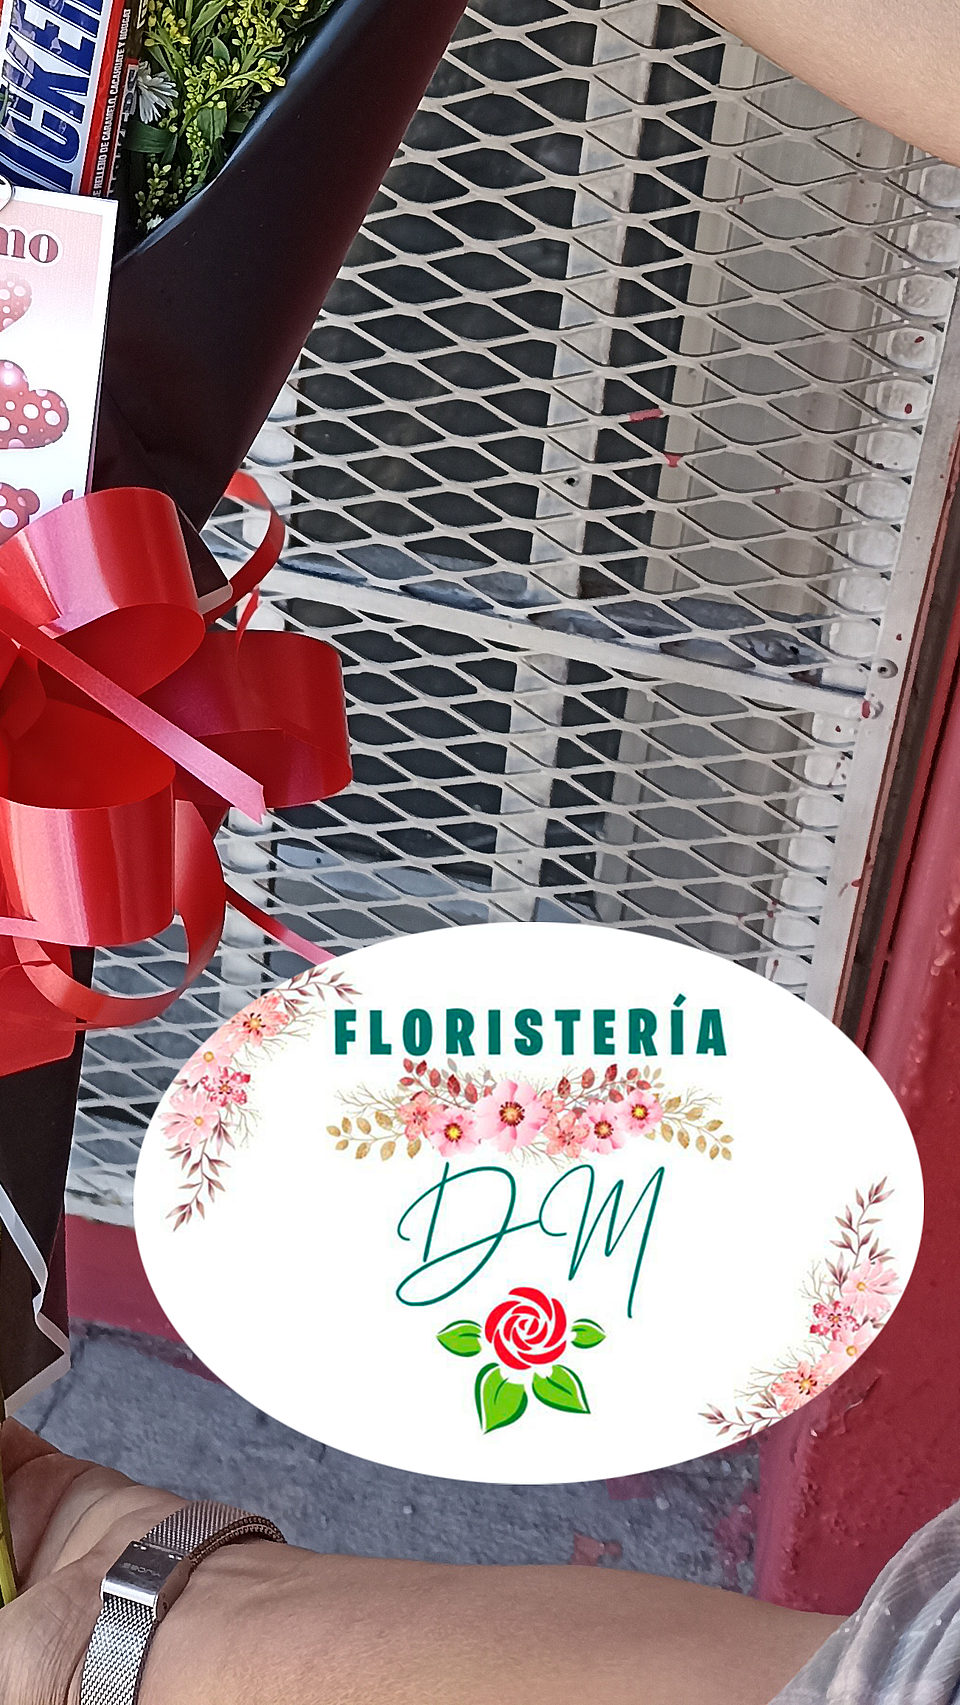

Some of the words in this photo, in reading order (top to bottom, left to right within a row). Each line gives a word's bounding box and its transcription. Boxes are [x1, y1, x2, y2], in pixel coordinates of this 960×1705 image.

[118, 8, 132, 40] NOUGAT
[117, 41, 127, 49] Y
[110, 48, 125, 95] CACAHUATE
[101, 95, 118, 141] CARAMELO,
[100, 141, 110, 153] DE
[93, 154, 108, 191] RELLENO
